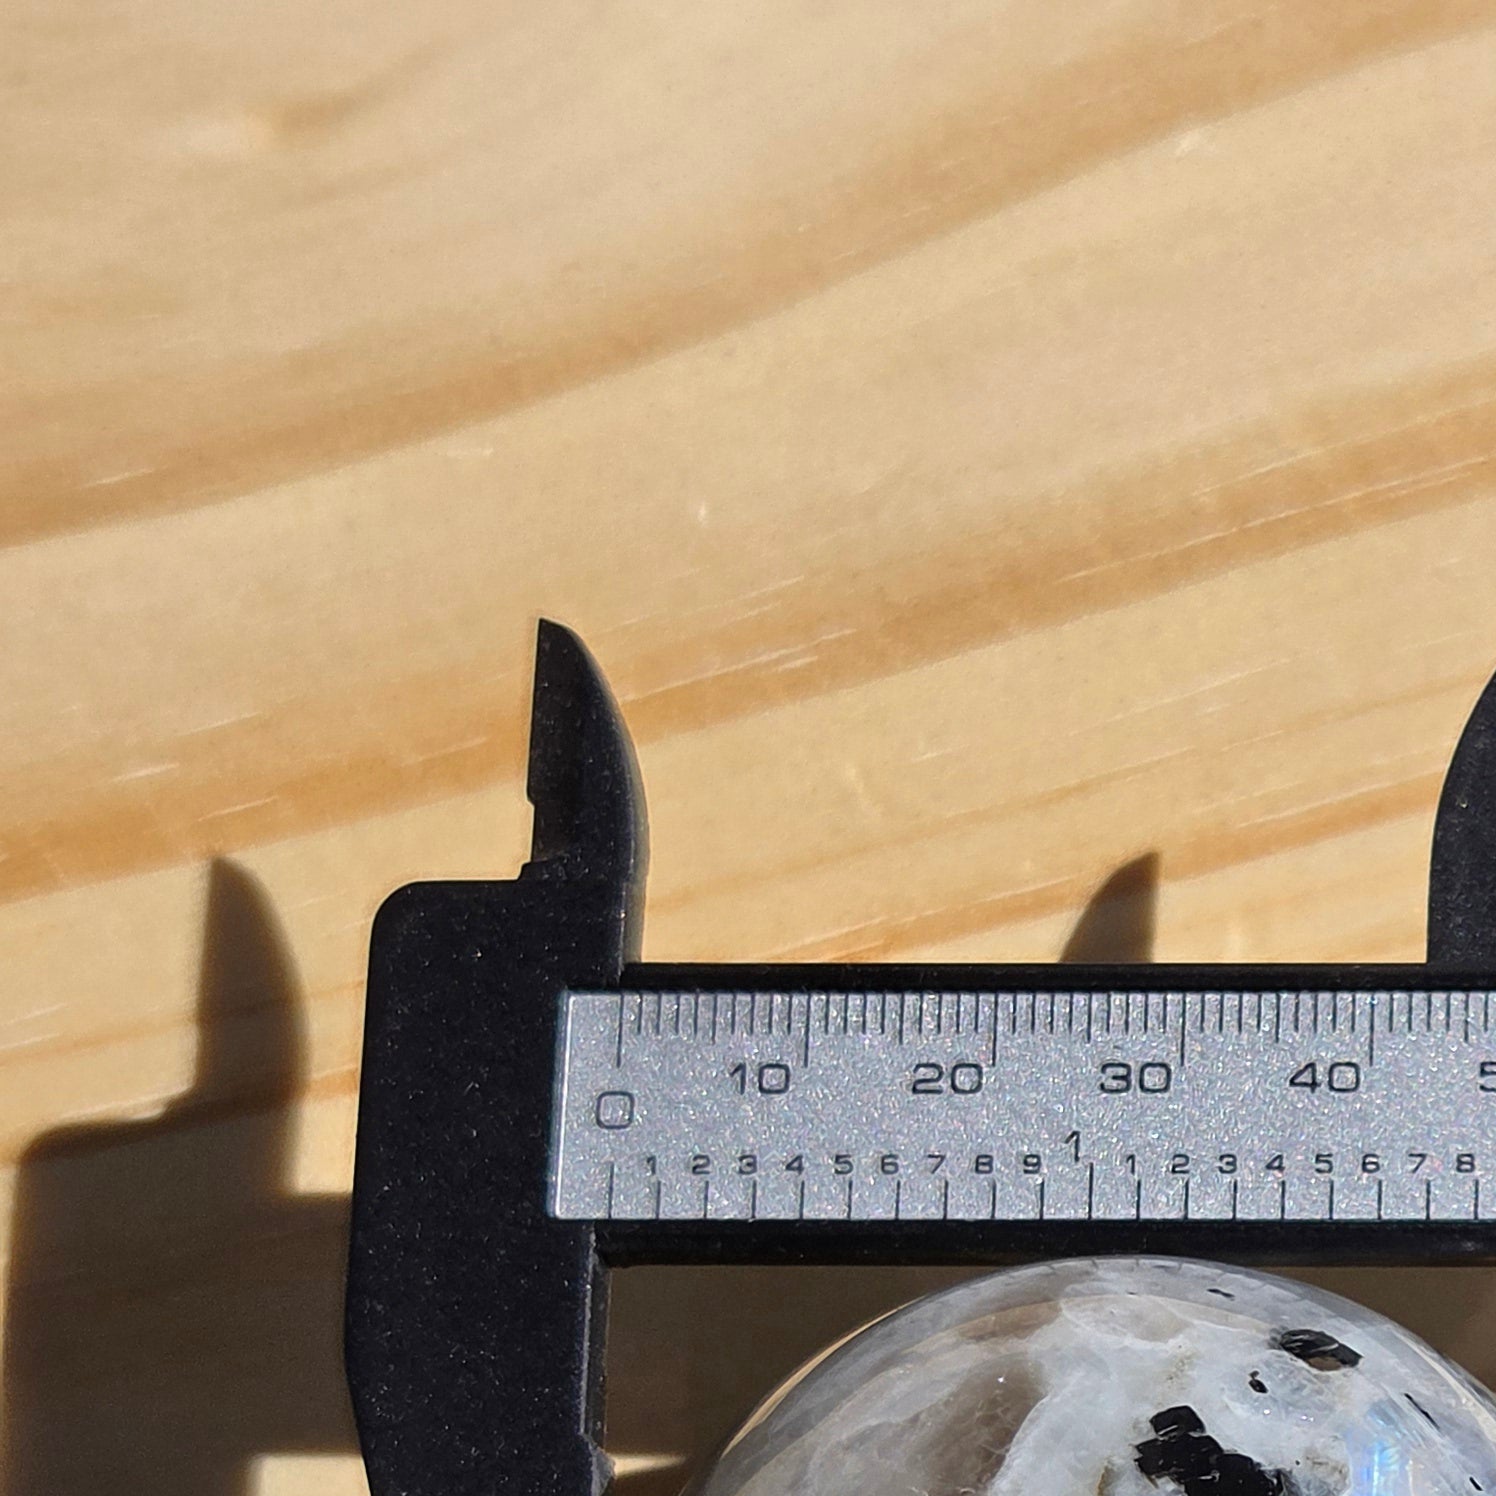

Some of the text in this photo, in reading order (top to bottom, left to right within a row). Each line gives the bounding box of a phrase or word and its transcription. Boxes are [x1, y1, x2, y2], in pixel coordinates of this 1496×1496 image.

[730, 1062, 791, 1095] 10
[911, 1062, 983, 1095] 20
[1100, 1062, 1172, 1094] 30
[1289, 1062, 1360, 1094] 40
[596, 1091, 635, 1130] 0
[646, 1154, 657, 1175] 1
[692, 1155, 711, 1175] 2
[738, 1154, 757, 1175] 3
[785, 1154, 804, 1175] 4
[834, 1154, 853, 1175] 5
[880, 1154, 899, 1175] 6
[927, 1154, 945, 1175] 7
[974, 1154, 993, 1175] 8
[1022, 1154, 1042, 1175] 9
[1065, 1131, 1081, 1162] 1
[1126, 1154, 1136, 1174] 1
[1171, 1154, 1189, 1174] 2
[1218, 1153, 1237, 1174] 3
[1266, 1153, 1285, 1174] 4
[1315, 1153, 1333, 1174] 5
[1361, 1153, 1380, 1174] 6
[1408, 1153, 1427, 1174] 7
[1456, 1153, 1475, 1174] 8
